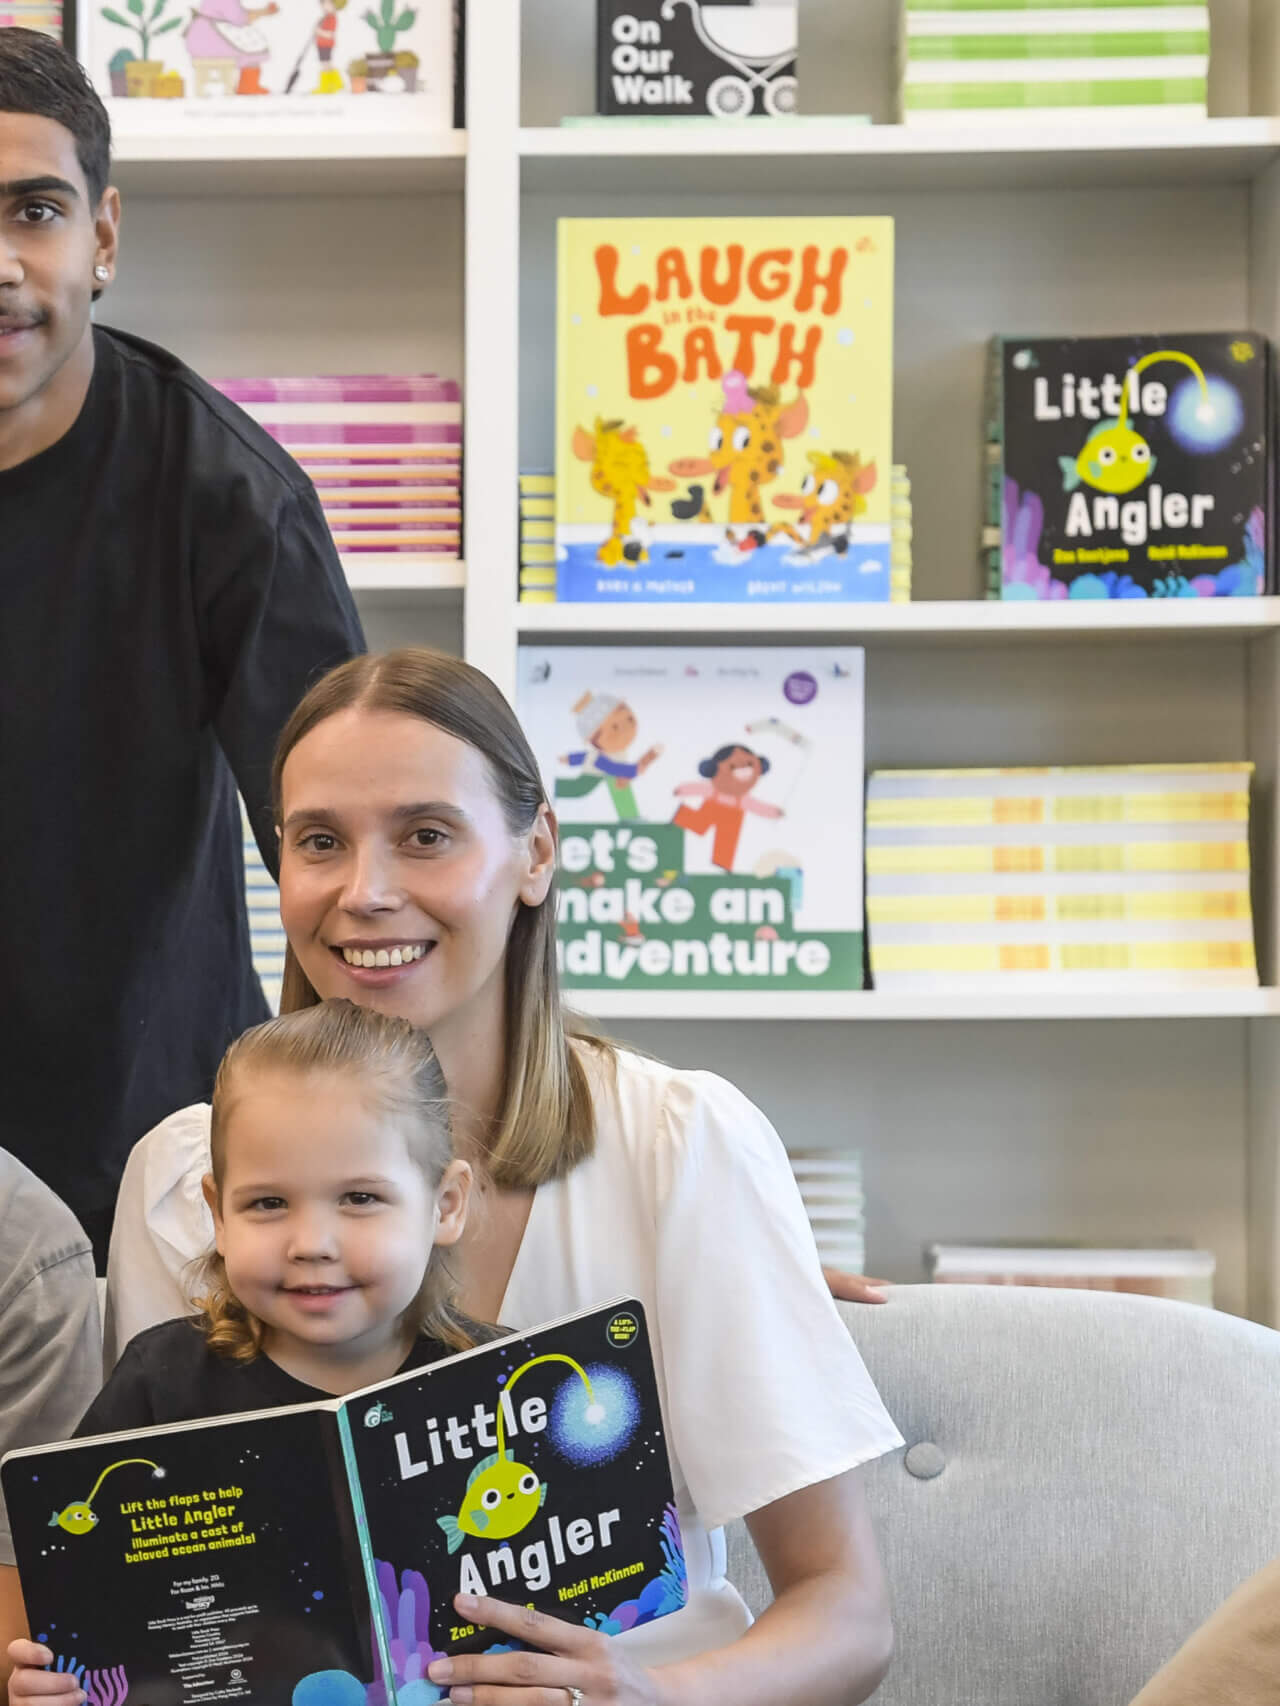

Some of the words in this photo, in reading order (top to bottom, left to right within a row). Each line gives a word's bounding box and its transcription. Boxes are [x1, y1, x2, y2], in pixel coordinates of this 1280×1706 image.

[611, 14, 661, 44] On
[611, 44, 674, 74] Our
[612, 74, 694, 104] Walk
[594, 243, 849, 317] LAUGH
[625, 314, 823, 400] BATH
[1033, 368, 1168, 421] Little
[1065, 484, 1215, 546] Angler
[558, 828, 658, 873] et's
[710, 887, 786, 925] an
[395, 1390, 548, 1480] Little
[120, 1502, 144, 1514] Lift
[146, 1498, 167, 1510] the
[169, 1494, 200, 1507] flaps
[202, 1490, 216, 1501] to
[218, 1485, 243, 1499] help
[130, 1512, 178, 1532] Little
[184, 1504, 236, 1525] Angler
[125, 1547, 169, 1563] beloved
[171, 1542, 207, 1556] ocean
[208, 1532, 256, 1550] animals!
[131, 1532, 189, 1549] illuminate
[190, 1531, 198, 1540] a
[201, 1524, 228, 1538] cast
[231, 1521, 244, 1533] of
[460, 1508, 621, 1598] Angler
[558, 1579, 589, 1602] Heidi
[590, 1561, 645, 1589] McKinnon
